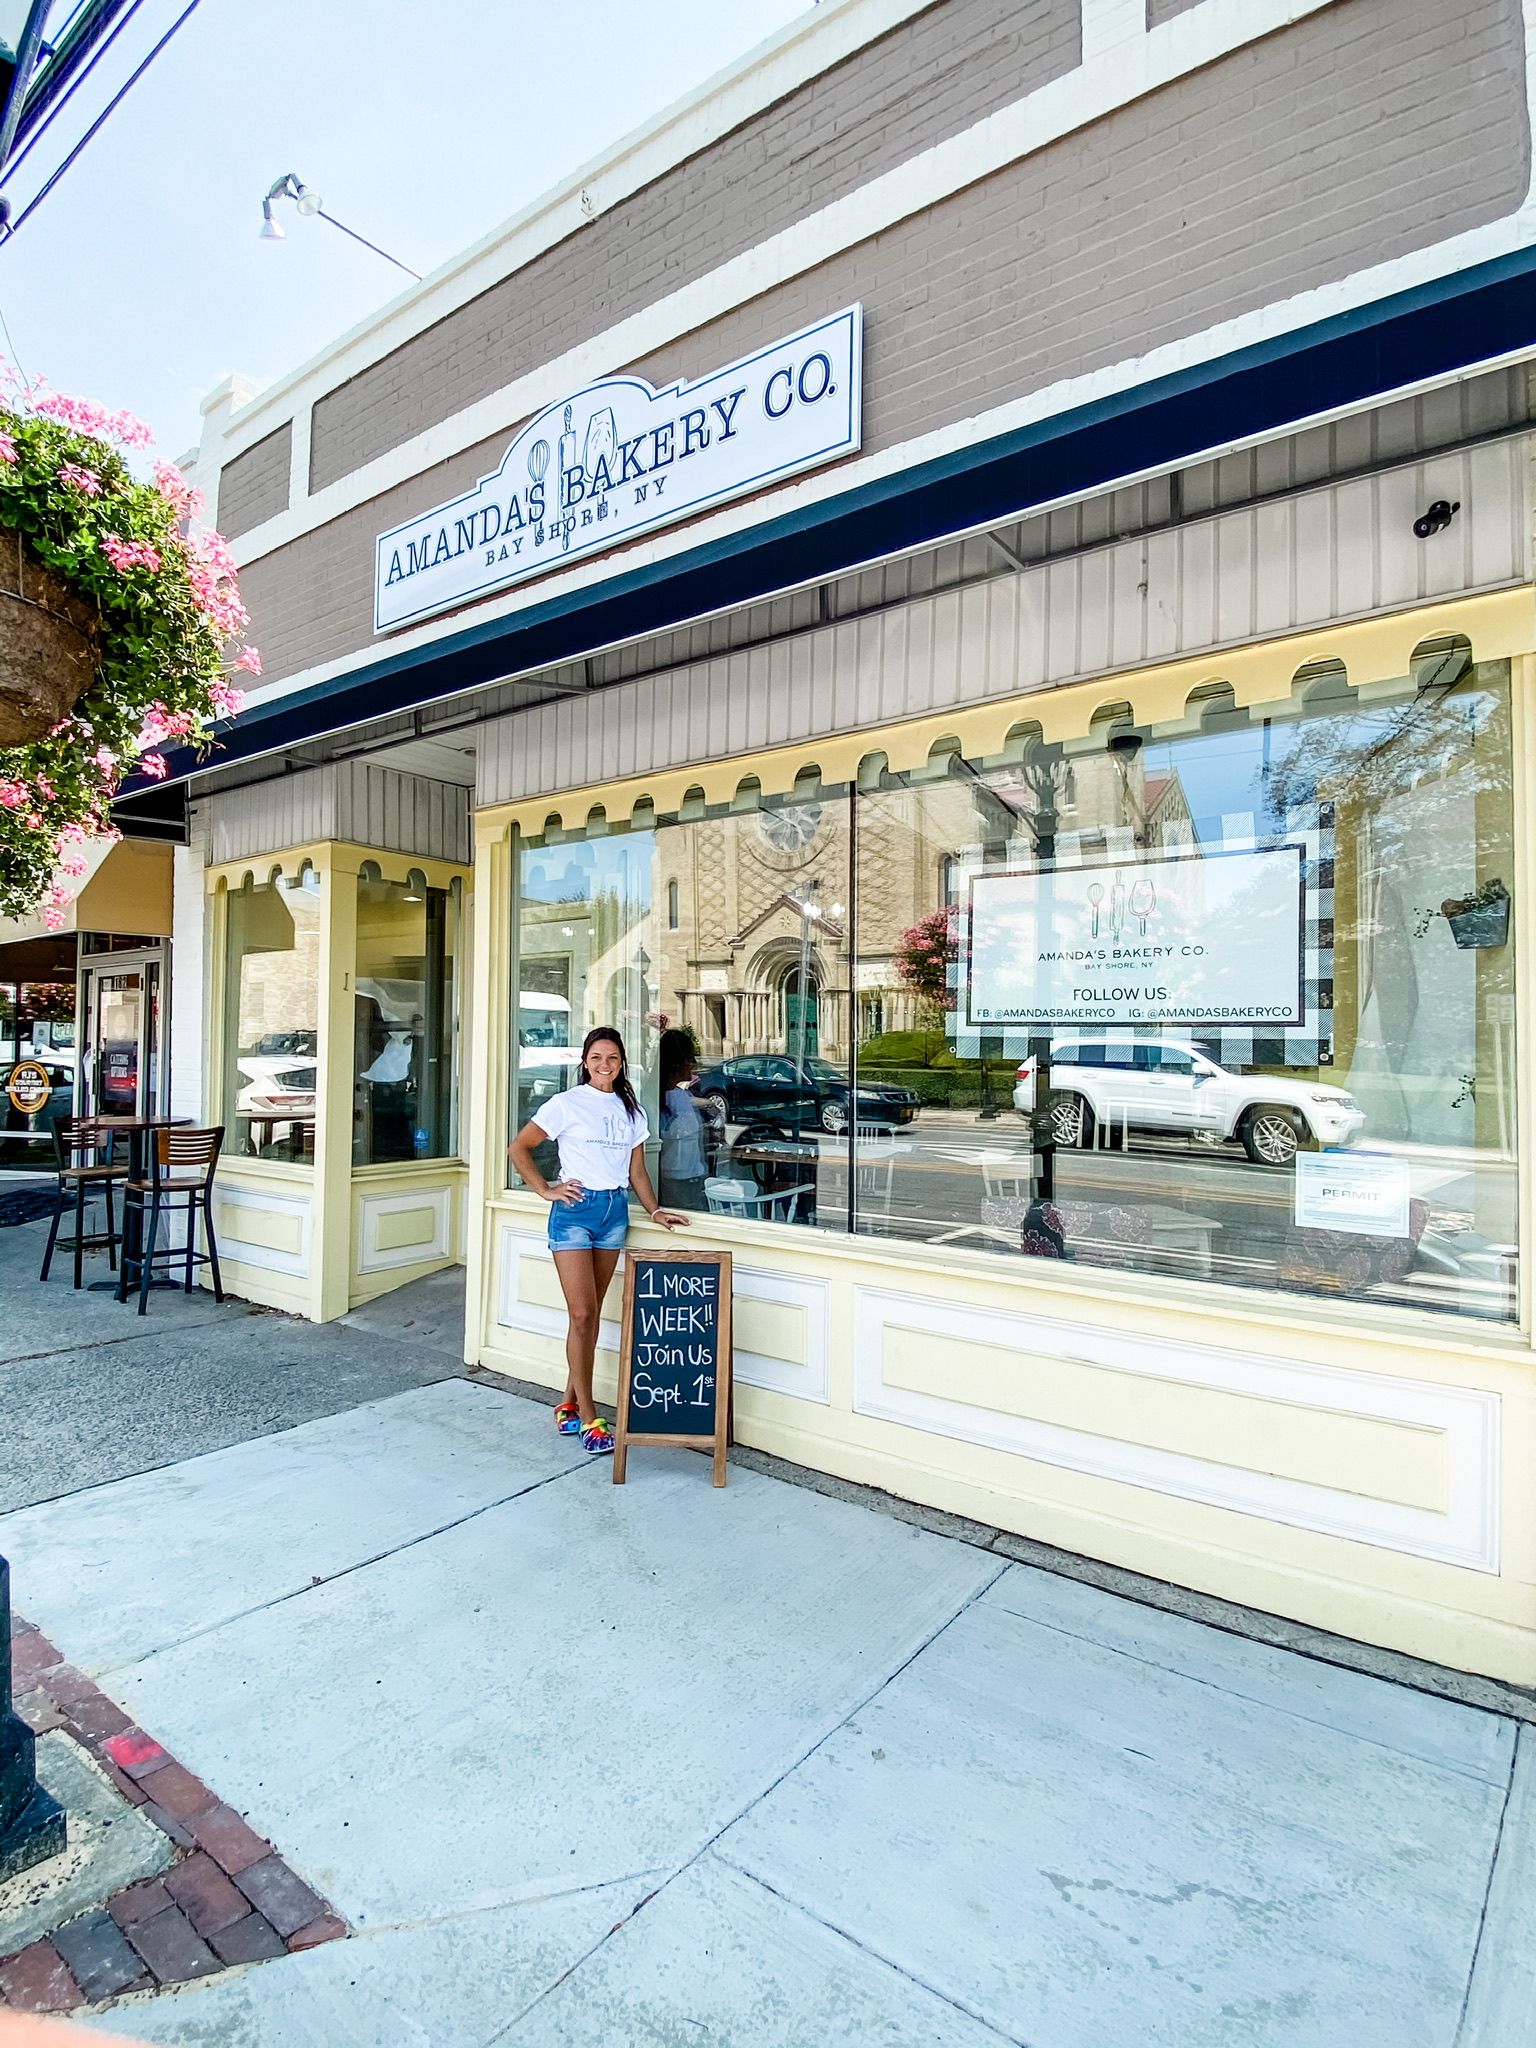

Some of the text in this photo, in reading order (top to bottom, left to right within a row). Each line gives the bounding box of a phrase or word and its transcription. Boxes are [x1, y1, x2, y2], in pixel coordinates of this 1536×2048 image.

[385, 352, 836, 587] AMANDA'S BAKERY CO.
[485, 476, 668, 567] BAY SHORE, NY
[1038, 945, 1210, 962] AMANDA'S BAKERY CO.
[1084, 963, 1102, 971] BAY
[1141, 961, 1154, 969] NY
[1073, 986, 1172, 1002] FOLLOW US:
[977, 1005, 1293, 1020] FB: @AMANDASBAKERYCO IG: @AMANDASBAKERYCO
[1322, 1188, 1381, 1201] PERMIT
[638, 1267, 716, 1298] 1 MORE
[640, 1303, 714, 1337] WEEK!!
[637, 1343, 713, 1367] Join Us
[632, 1372, 688, 1413] Sept.
